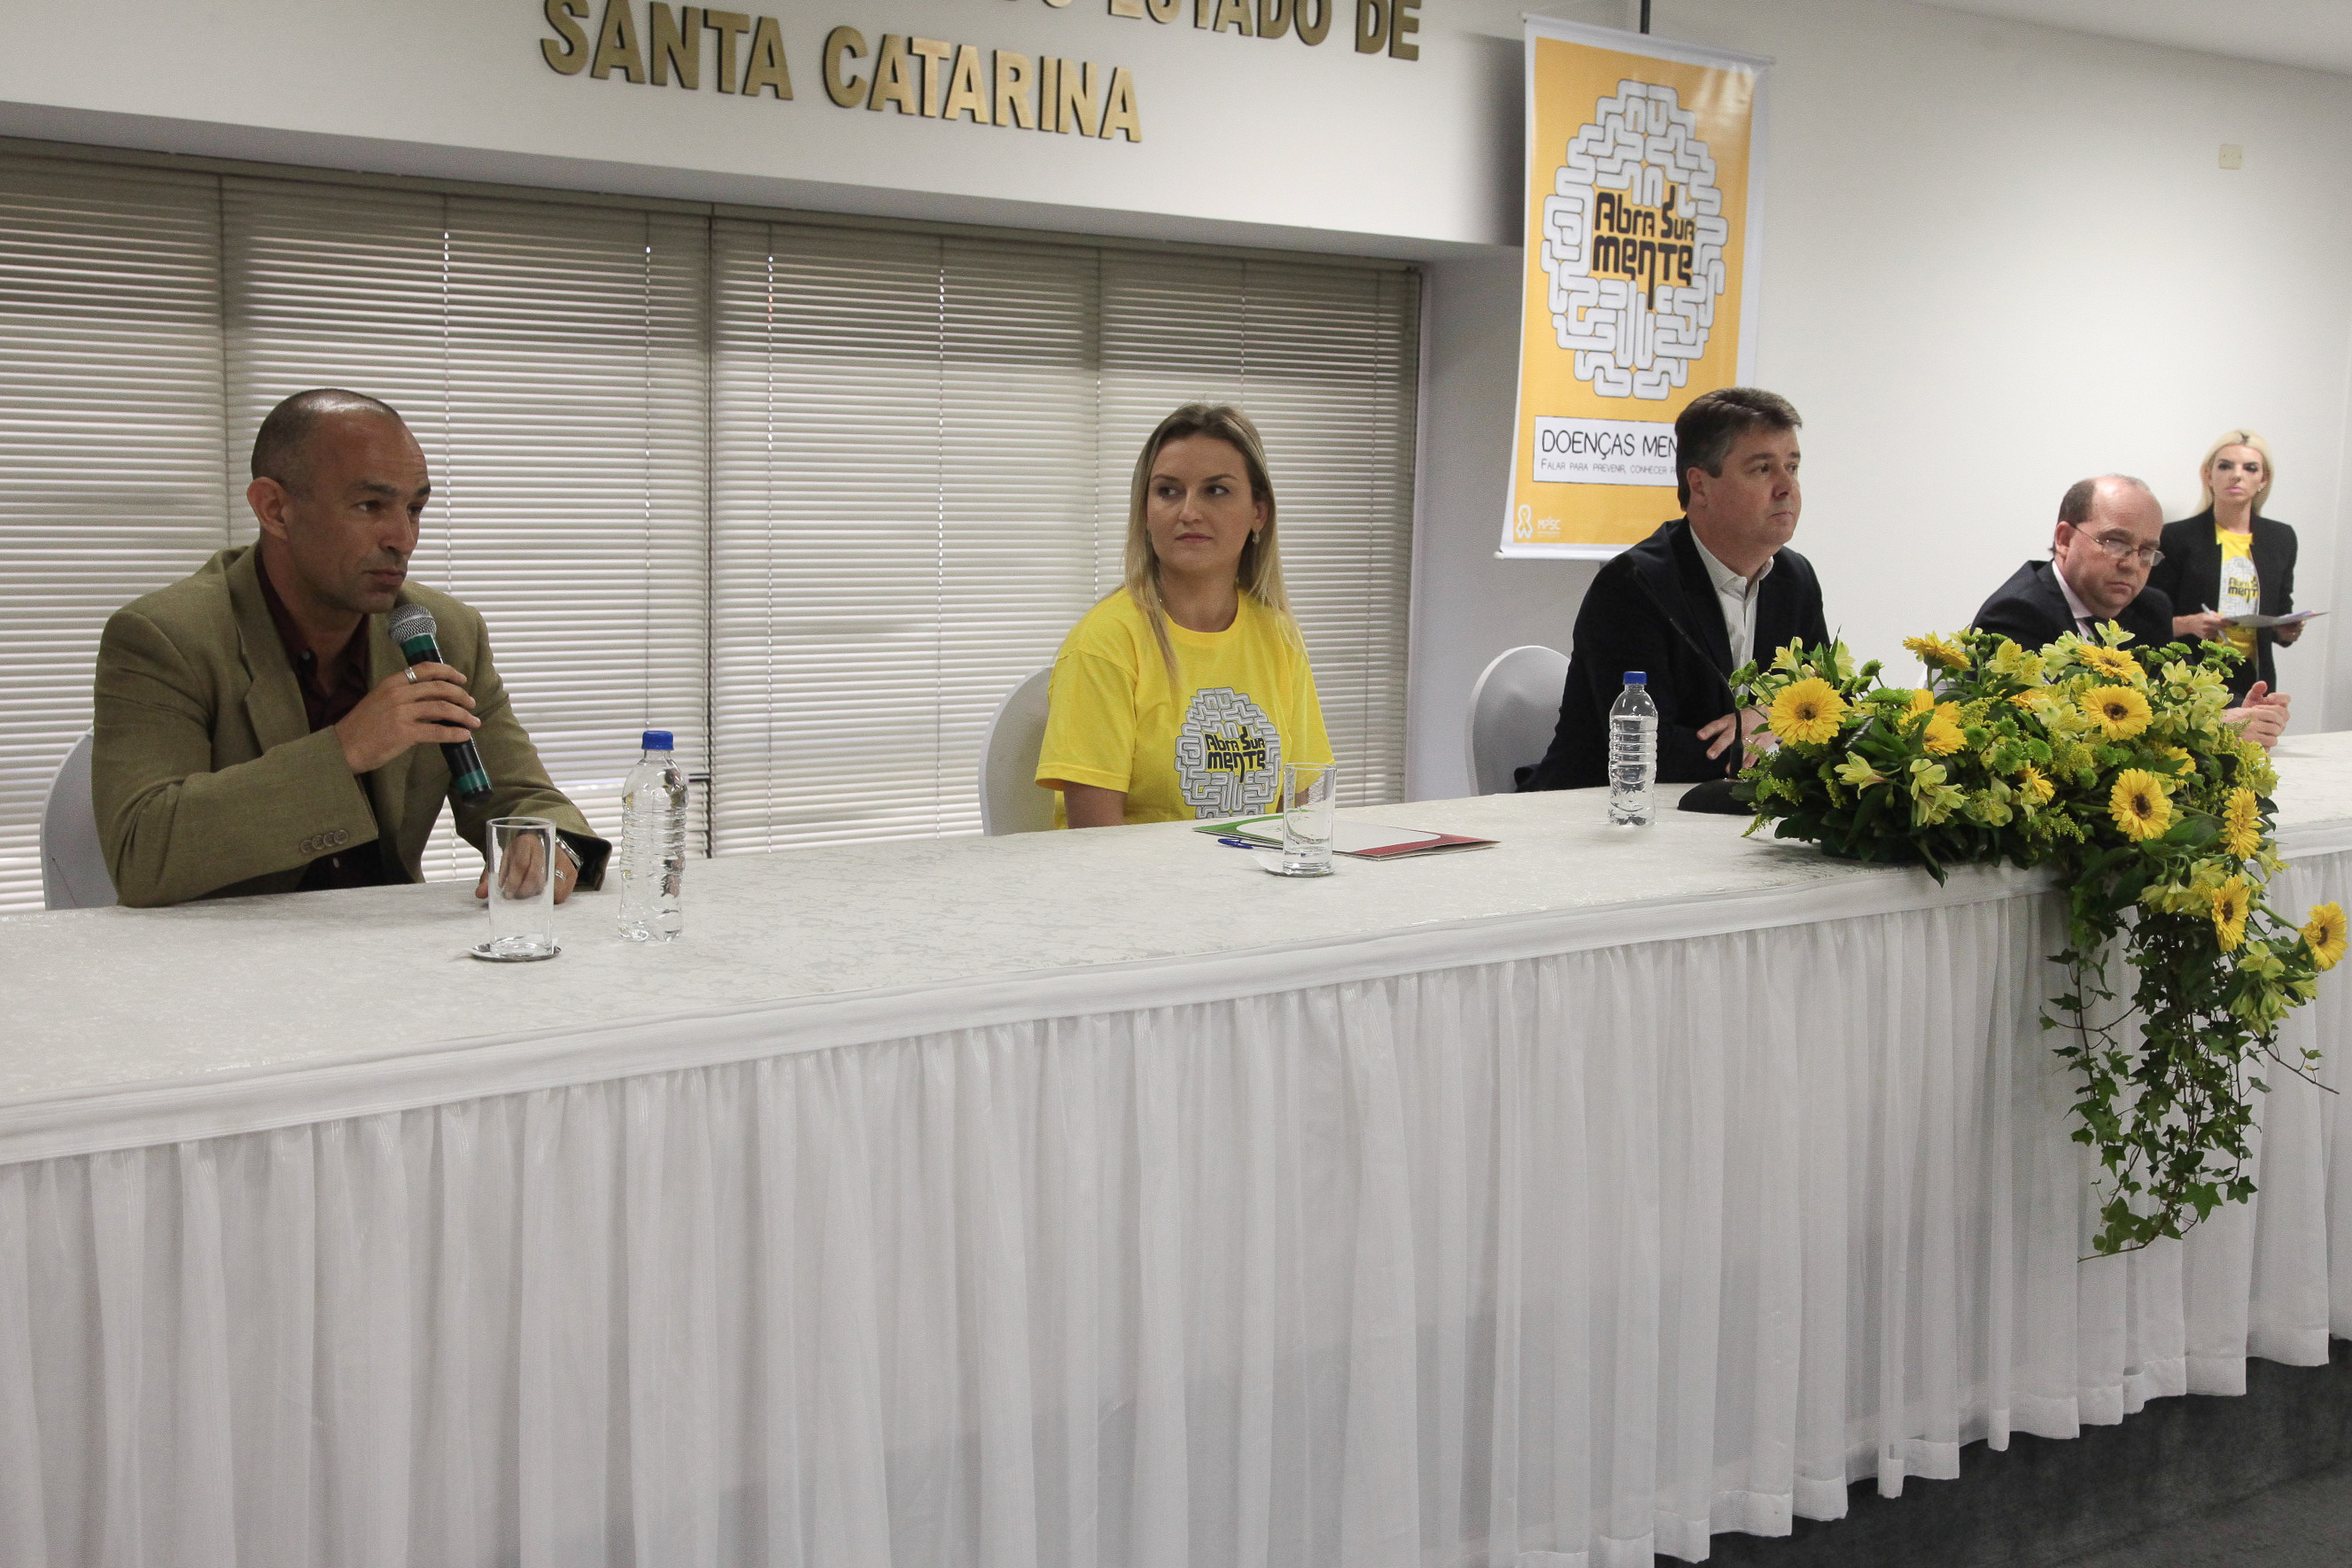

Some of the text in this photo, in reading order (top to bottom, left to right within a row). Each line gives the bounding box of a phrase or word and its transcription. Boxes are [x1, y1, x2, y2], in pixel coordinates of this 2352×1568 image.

[1109, 0, 1420, 61] ADO DE
[540, 0, 1142, 143] SANTA CATARINA
[1541, 429, 1635, 461] DOENÇAS
[1569, 462, 1588, 472] PARA
